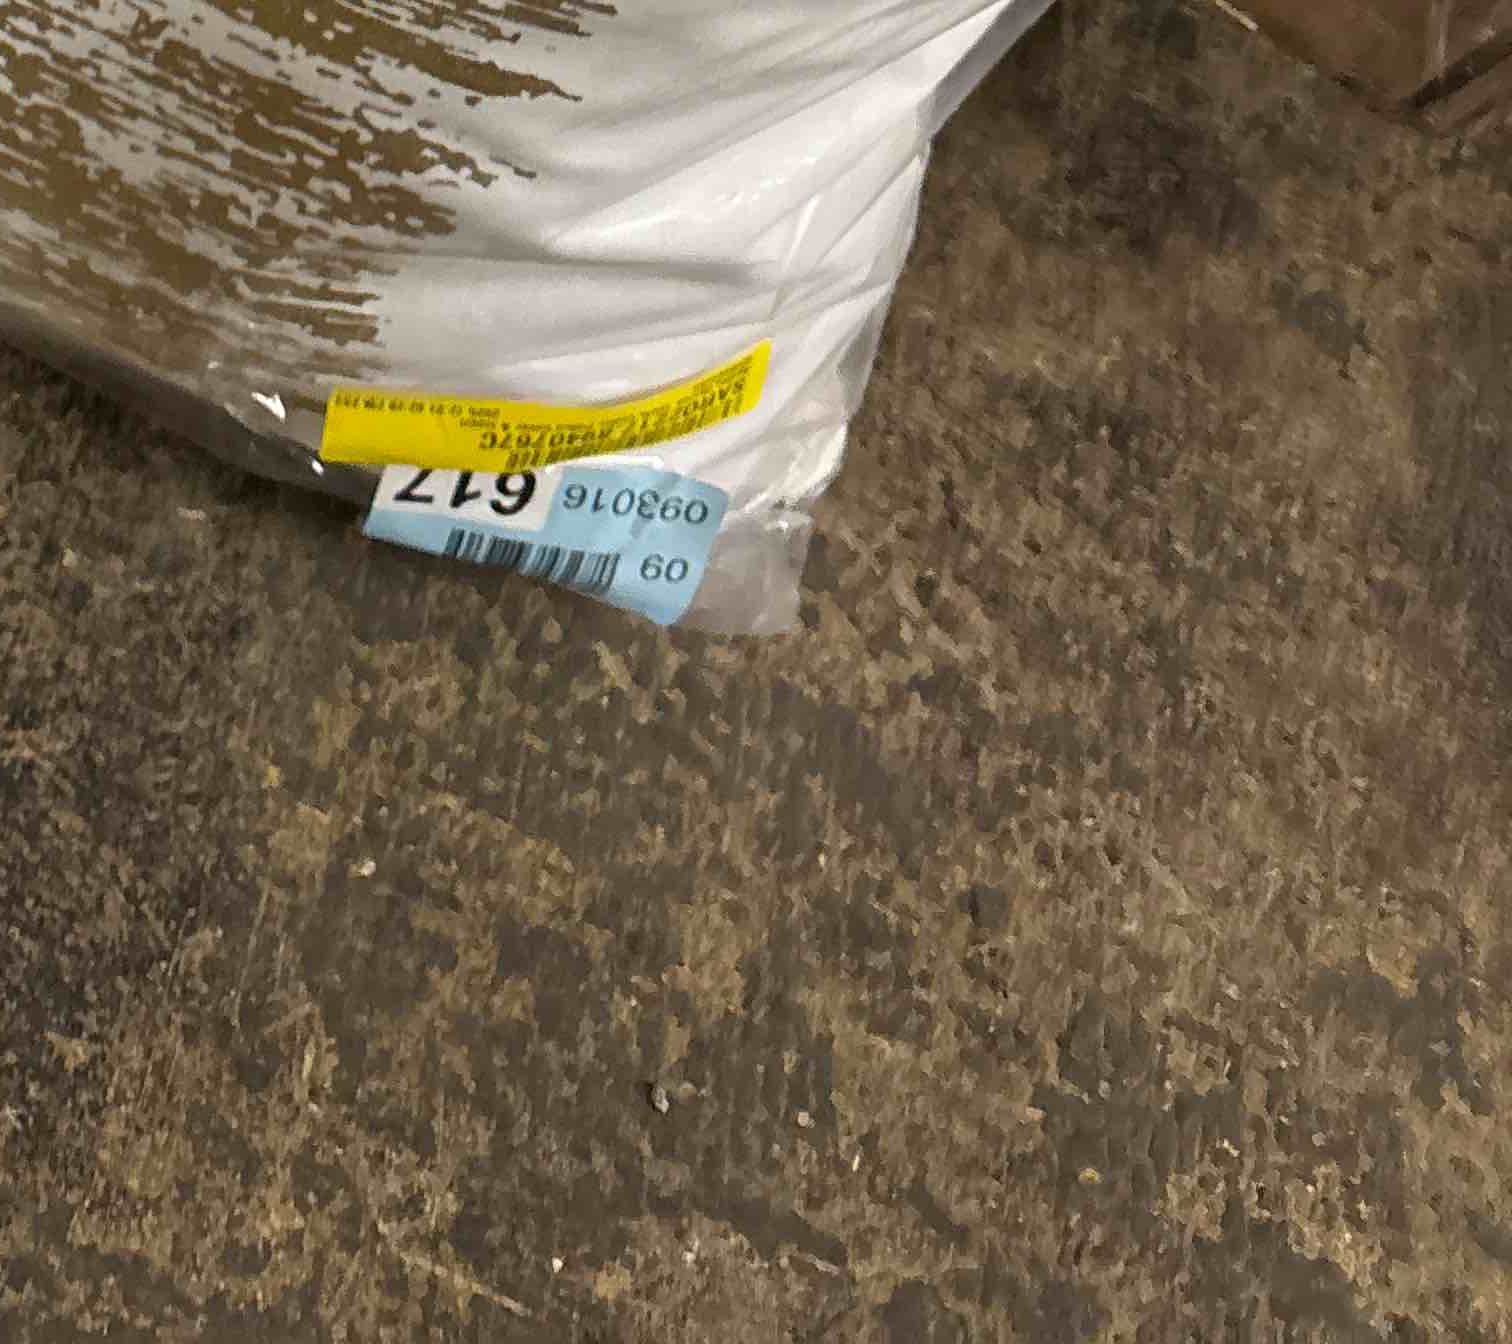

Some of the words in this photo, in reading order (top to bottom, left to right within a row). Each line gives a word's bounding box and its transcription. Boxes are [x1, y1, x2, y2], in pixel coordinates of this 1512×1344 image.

[394, 469, 536, 515] 617
[562, 483, 709, 525] 093016
[639, 552, 688, 582] 09
